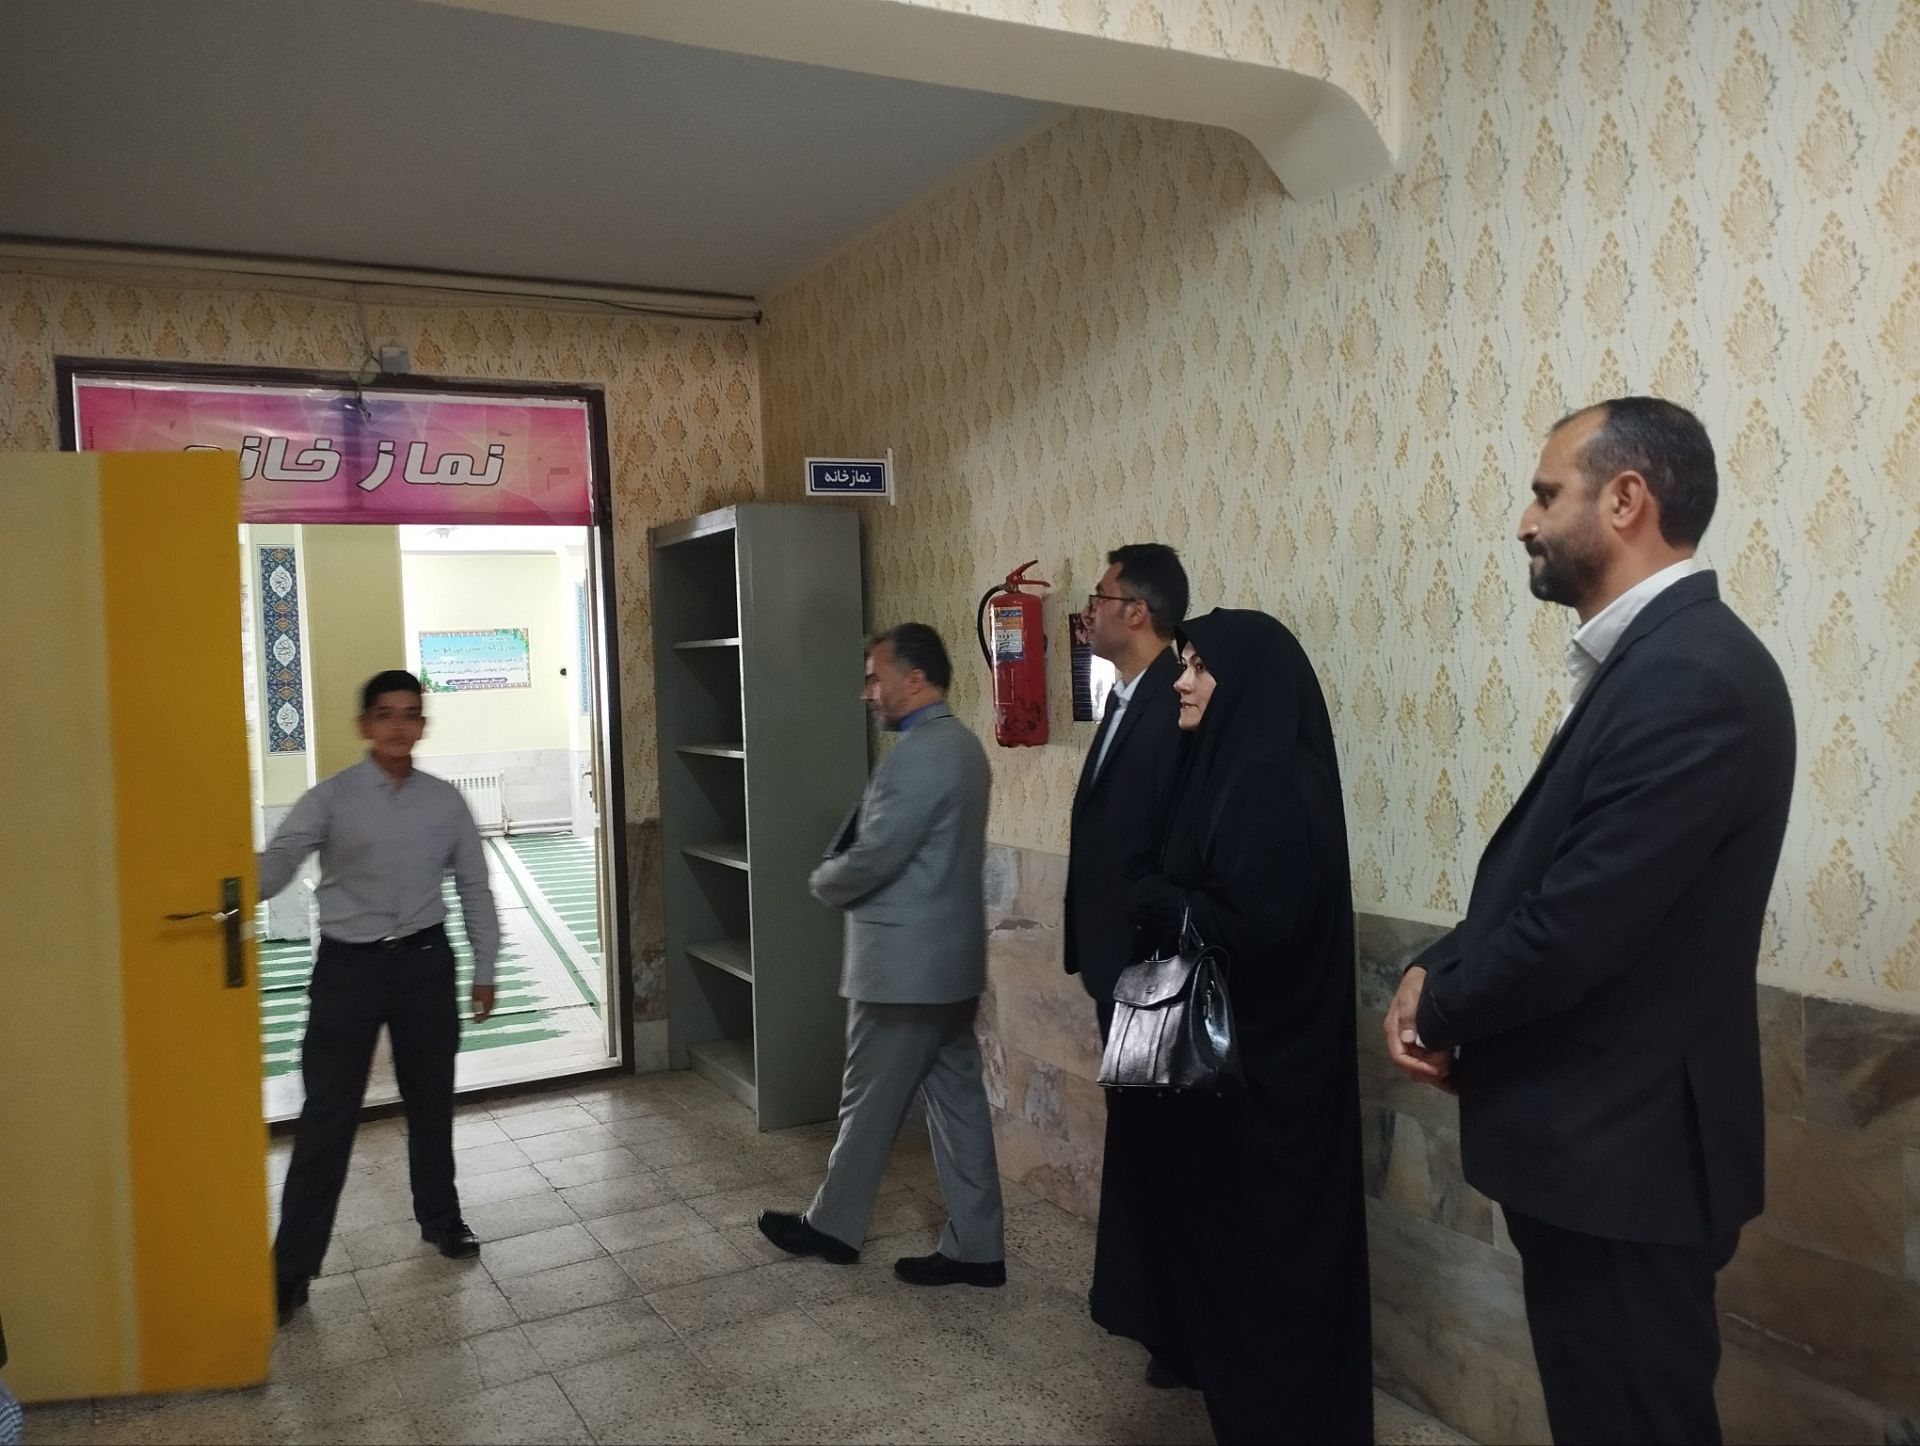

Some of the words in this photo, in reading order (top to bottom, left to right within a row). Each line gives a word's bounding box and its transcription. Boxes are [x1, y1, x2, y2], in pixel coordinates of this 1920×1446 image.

[184, 436, 342, 482] خان
[357, 440, 506, 492] نماز
[824, 469, 871, 487] نمازخانه
